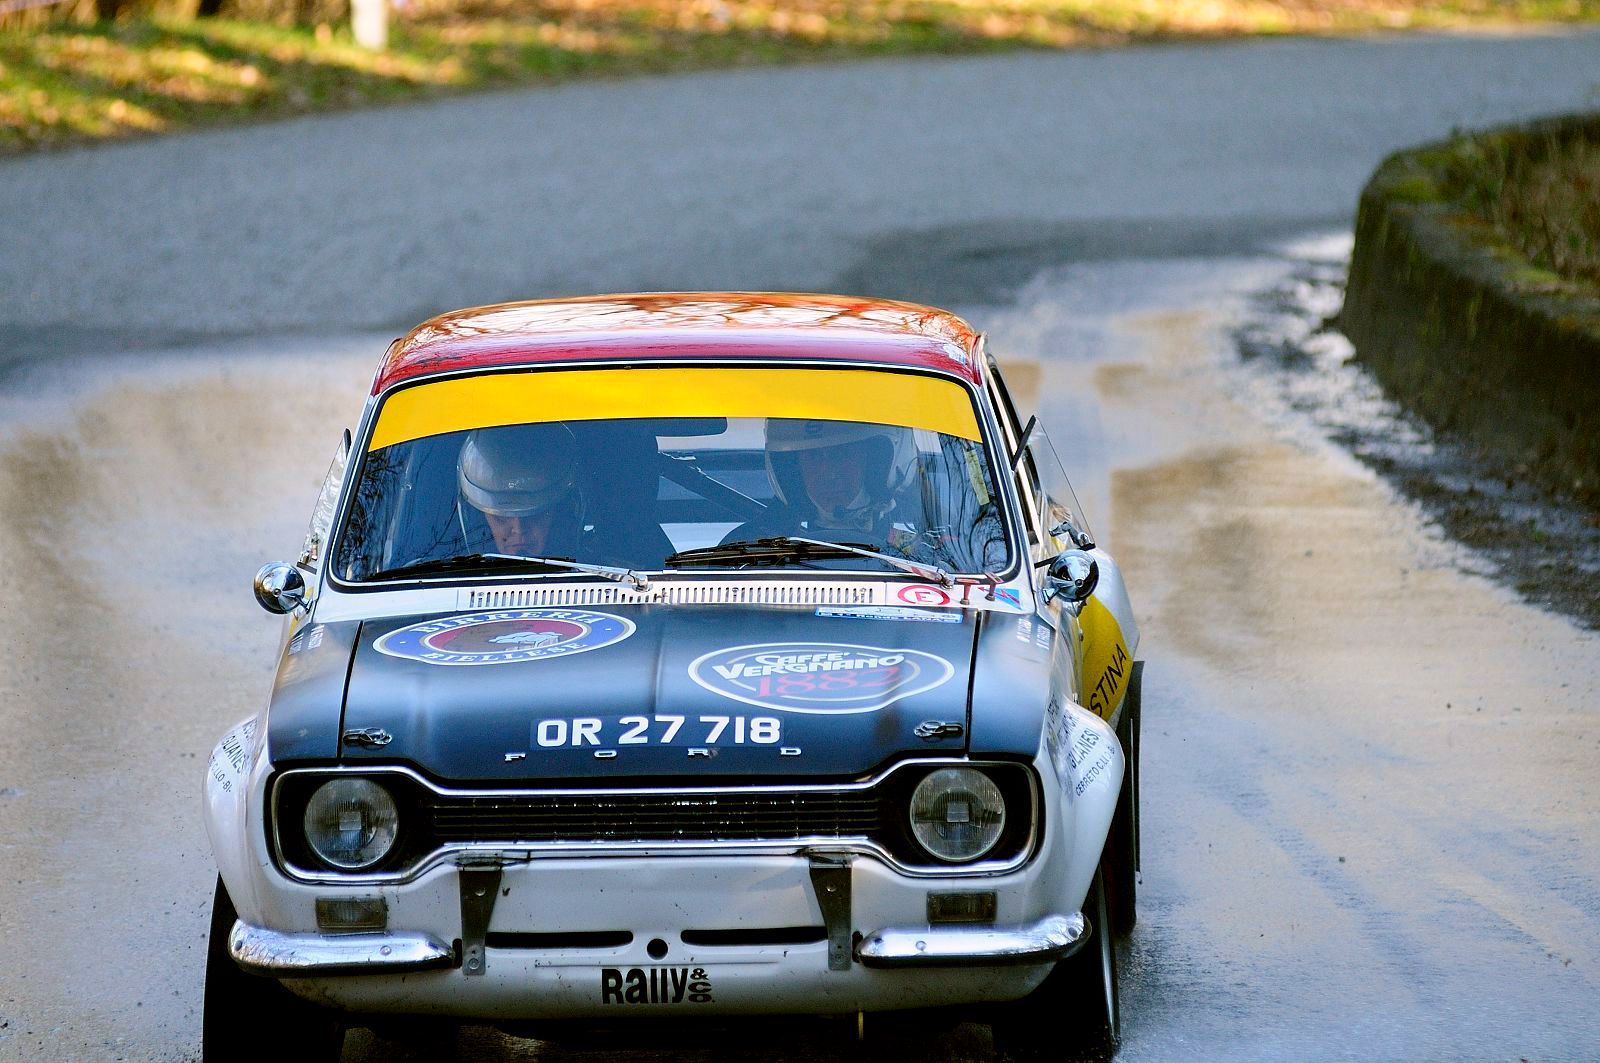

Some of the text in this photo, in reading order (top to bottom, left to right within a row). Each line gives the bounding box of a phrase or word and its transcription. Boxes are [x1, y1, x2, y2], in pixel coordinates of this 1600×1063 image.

[914, 591, 934, 604] E
[409, 611, 606, 633] BIRRERIA
[421, 643, 588, 663] BIELLESE
[712, 653, 905, 679] VERGNANO
[758, 666, 900, 698] 1882
[1087, 643, 1127, 718] STINA
[537, 715, 781, 747] OR 27 718
[504, 747, 802, 762] FORD
[601, 968, 689, 1005] Rally
